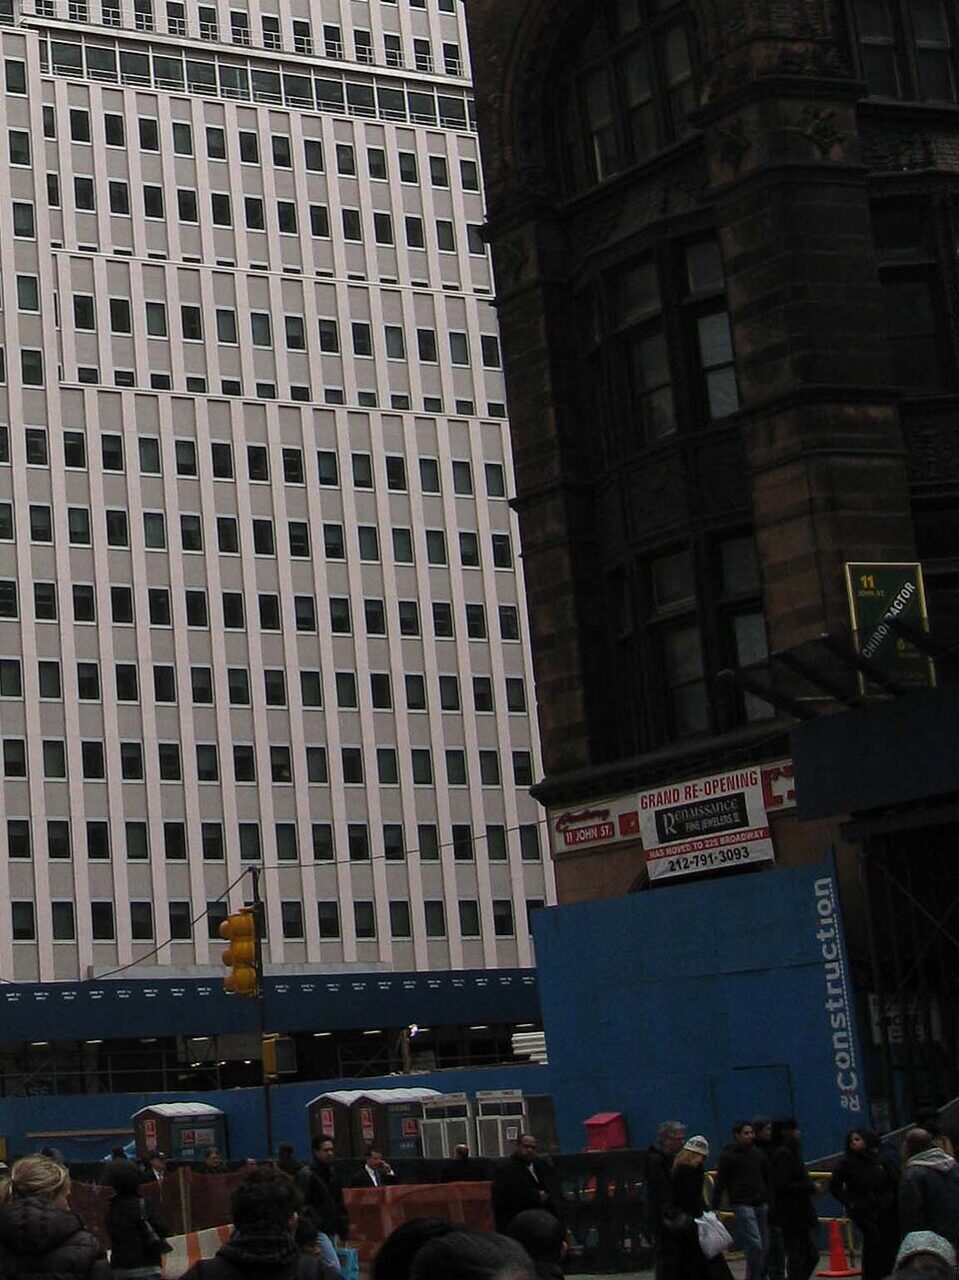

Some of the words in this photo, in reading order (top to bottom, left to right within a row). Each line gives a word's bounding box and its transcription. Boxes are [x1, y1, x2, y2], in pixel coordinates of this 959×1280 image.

[860, 575, 874, 589] 11
[640, 789, 680, 810] GRAND
[684, 770, 758, 800] RE-OPENING
[565, 831, 573, 844] 11
[575, 828, 598, 842] JOHN
[648, 848, 665, 859] HAS
[666, 843, 691, 856] MOVED
[693, 841, 704, 851] TO
[720, 829, 764, 846] BROADWAY
[669, 846, 750, 871] 212-791-3093
